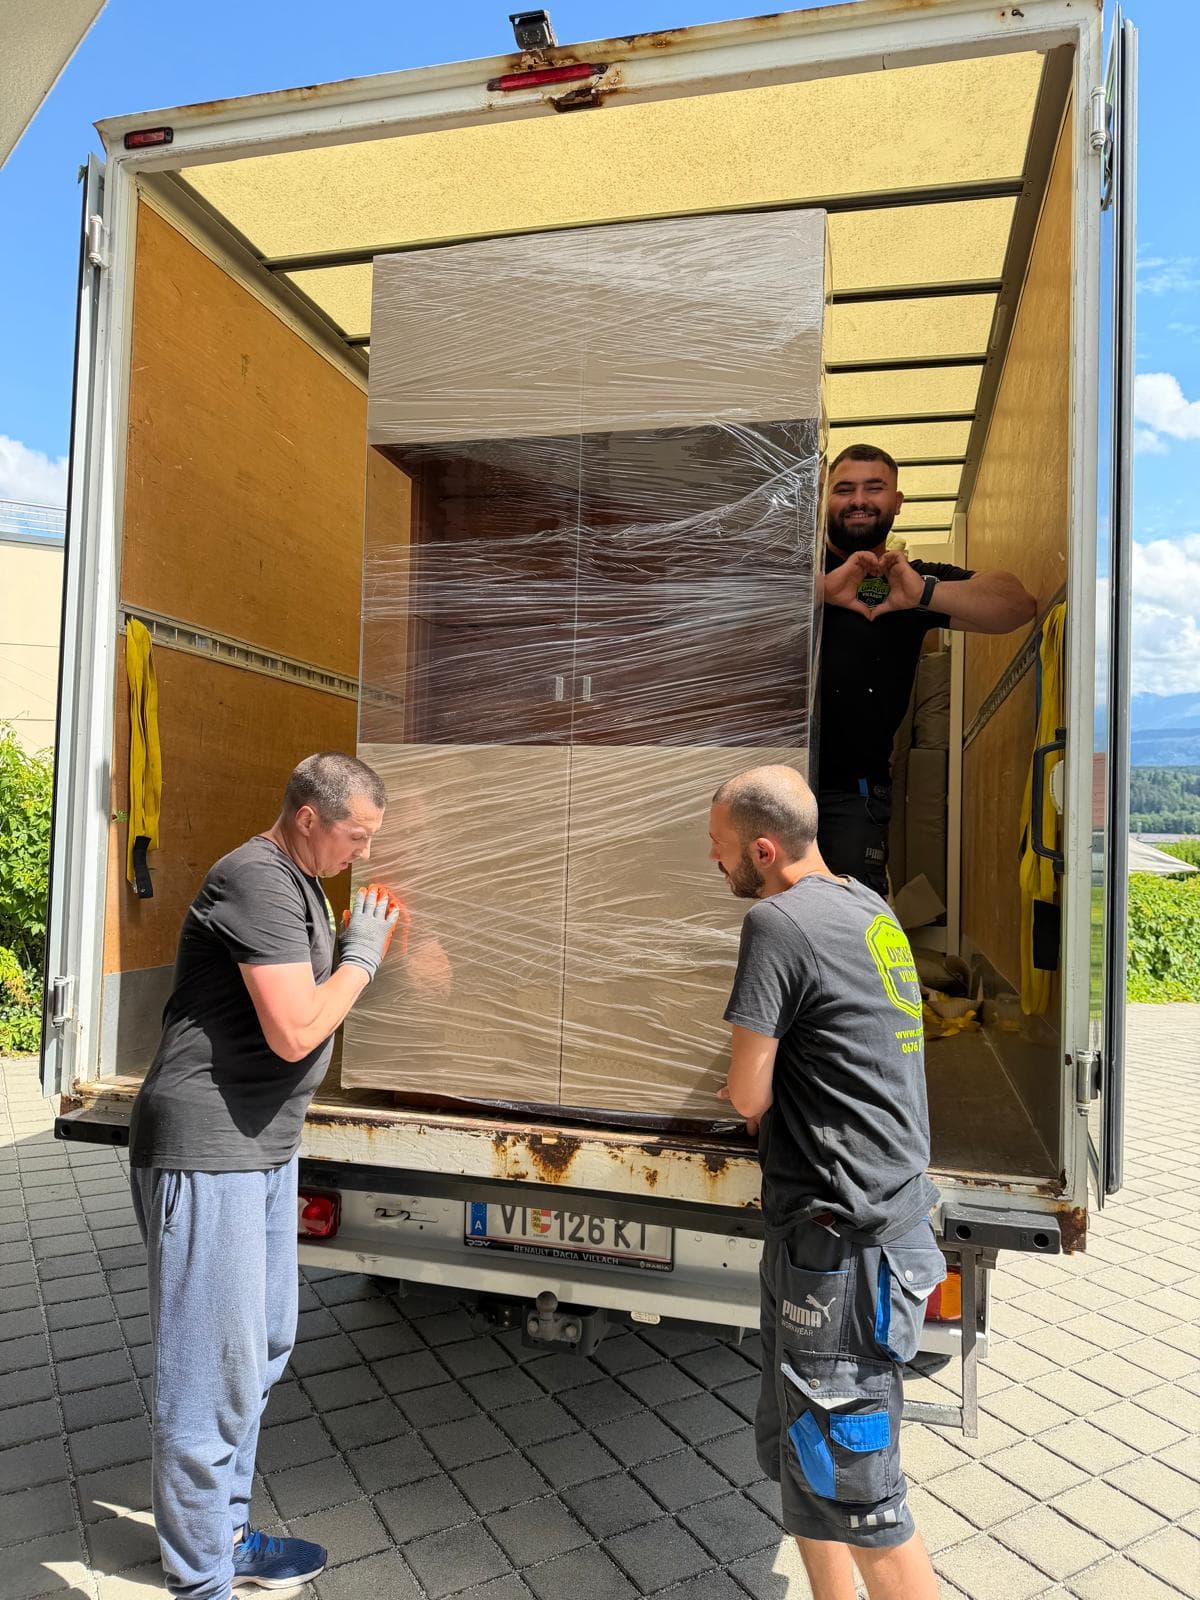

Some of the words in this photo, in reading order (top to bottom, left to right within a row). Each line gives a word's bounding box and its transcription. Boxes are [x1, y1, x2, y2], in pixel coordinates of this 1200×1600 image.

[474, 1219, 483, 1231] A
[500, 1203, 527, 1236] VI
[553, 1211, 605, 1245] 126
[513, 1245, 550, 1257] RENAULT
[553, 1249, 579, 1261] DACIA
[582, 1253, 619, 1265] VILLACH
[782, 1299, 821, 1328] PUMA
[782, 1320, 814, 1336] WORKWEAR
